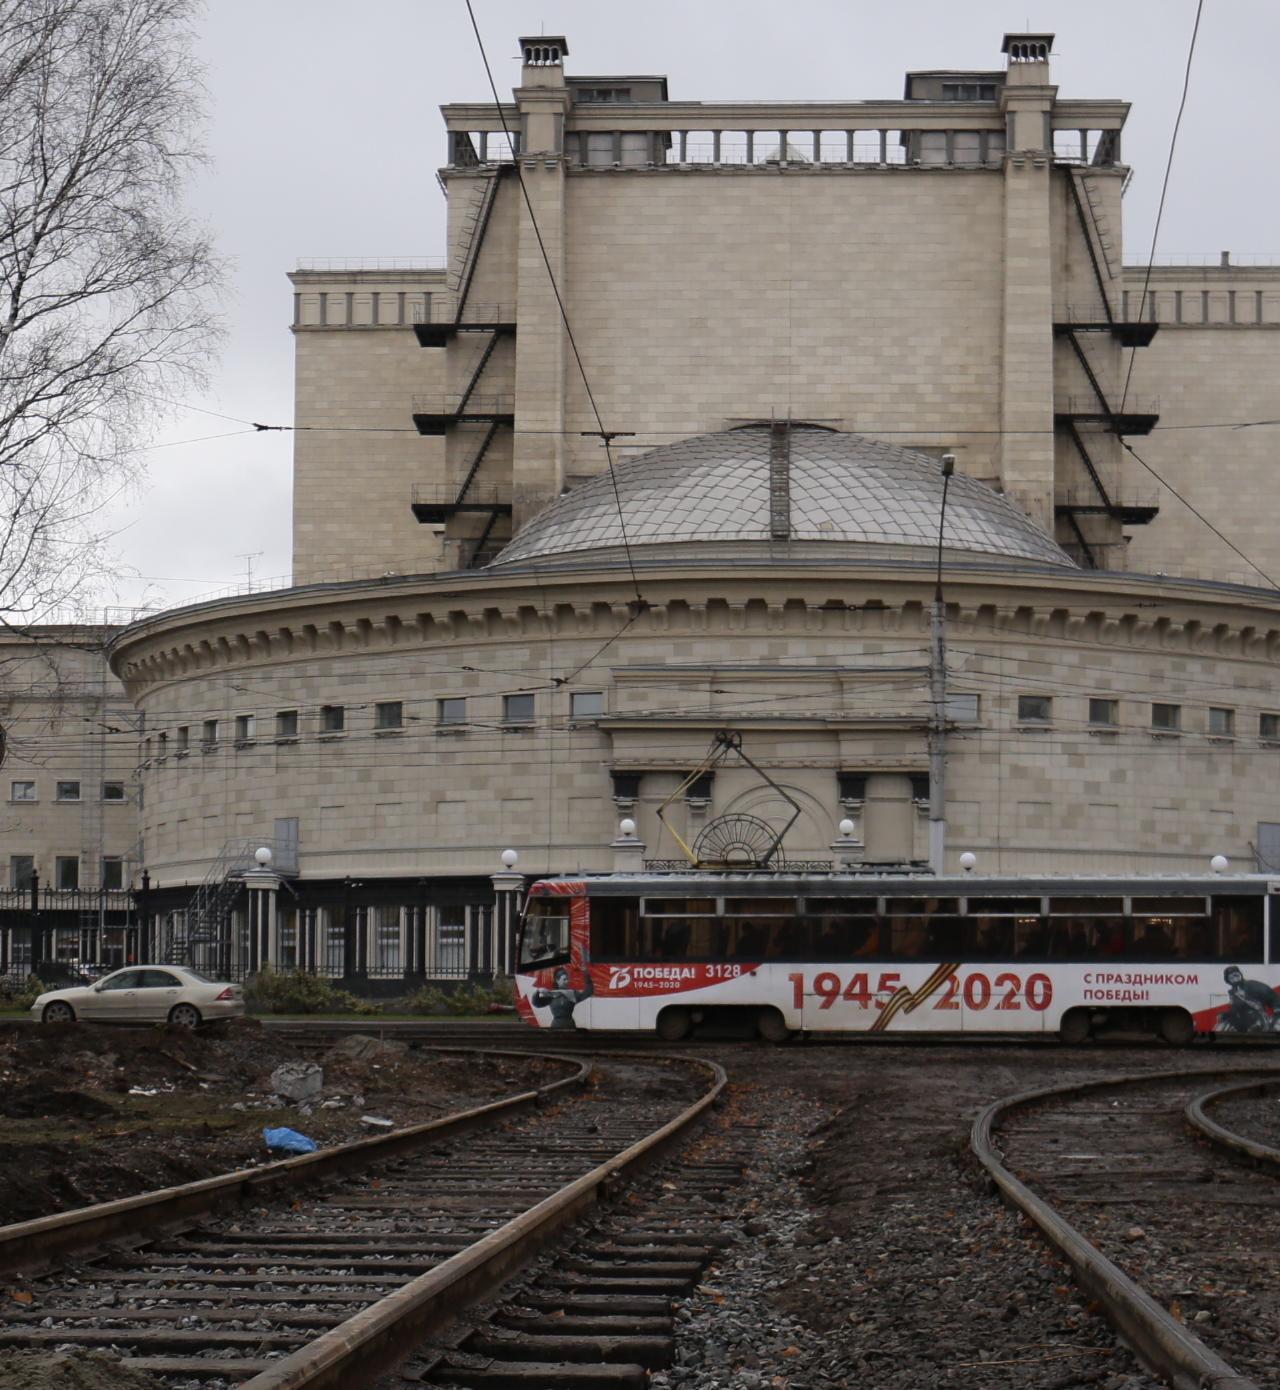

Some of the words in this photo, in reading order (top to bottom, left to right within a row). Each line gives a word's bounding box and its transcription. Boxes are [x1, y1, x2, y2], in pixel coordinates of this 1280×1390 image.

[634, 967, 696, 980] ПОБЕДА!
[705, 964, 741, 978] 3128
[1083, 973, 1092, 984] С
[1096, 973, 1199, 986] ПРАЗДНИКОМ
[788, 972, 901, 1010] 1945
[932, 972, 1053, 1012] 2020
[1083, 989, 1149, 1002] ПОБЕДЫ!
